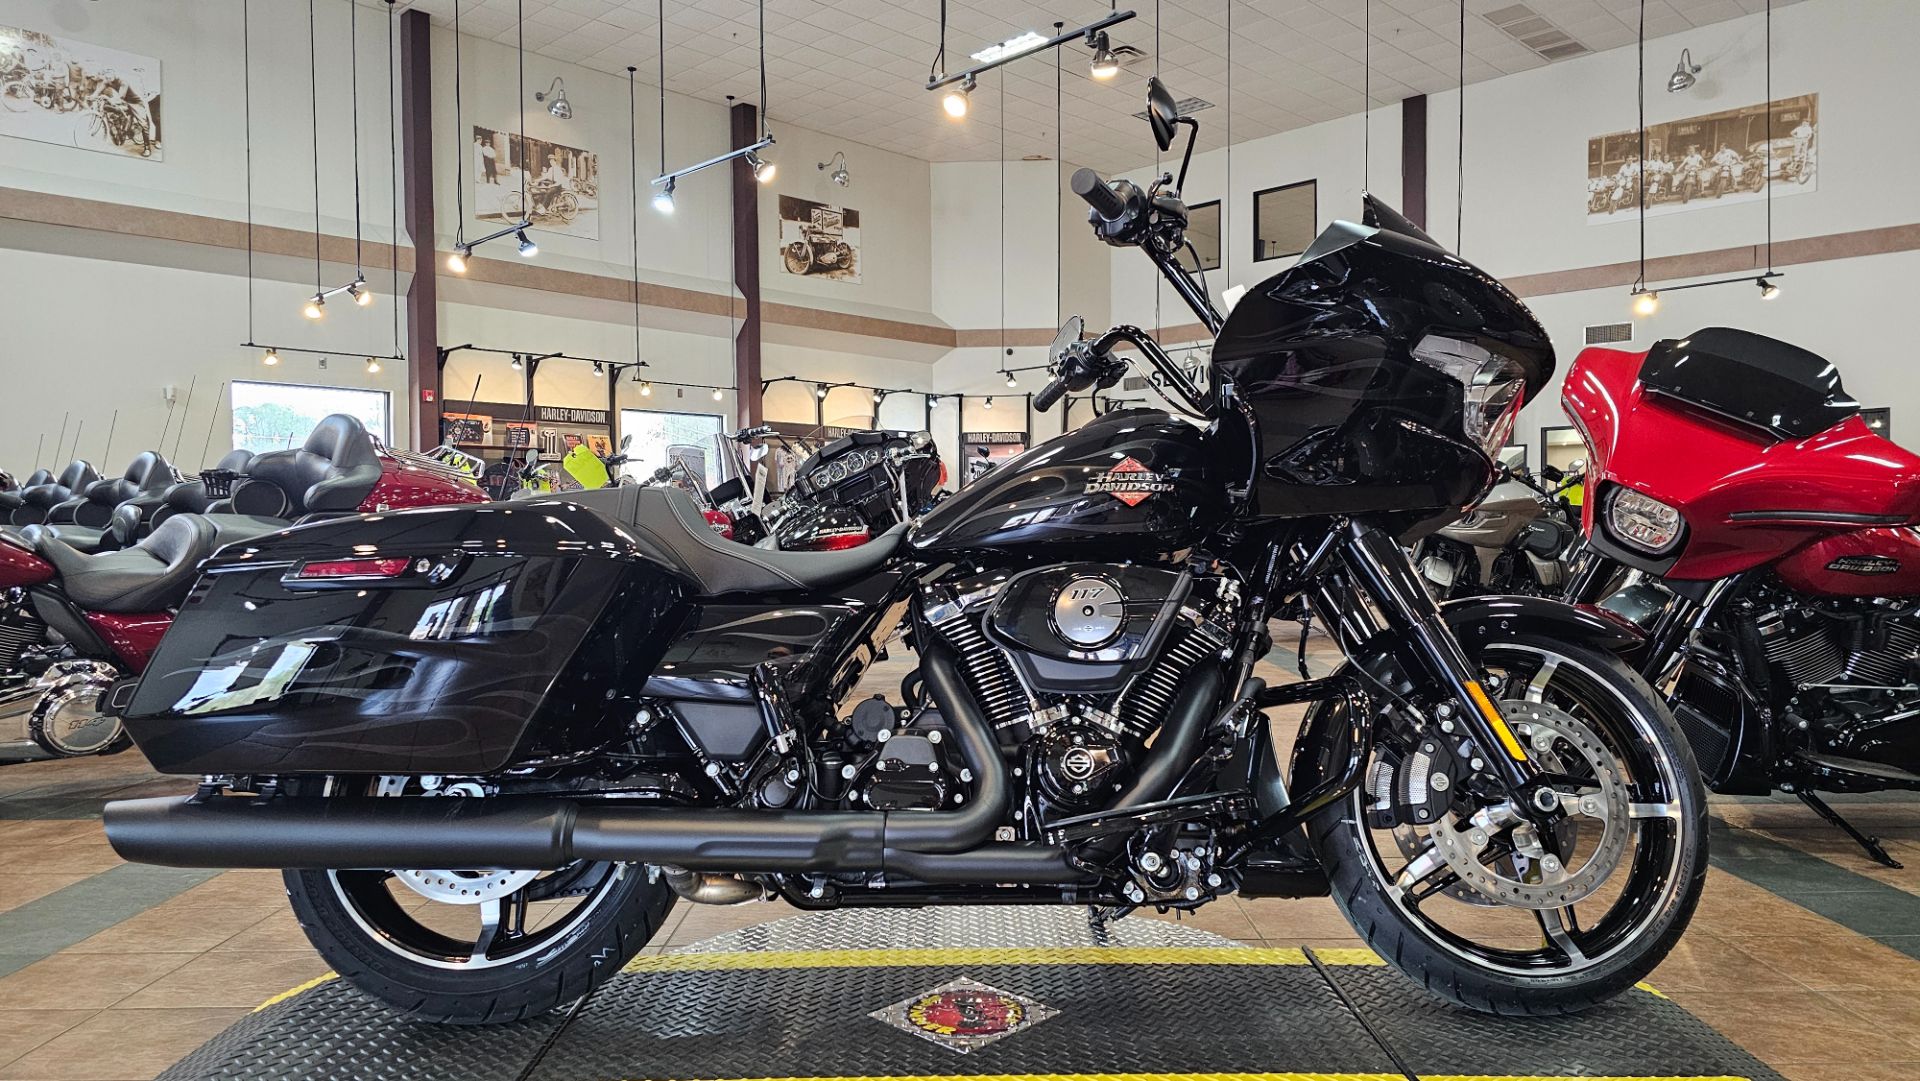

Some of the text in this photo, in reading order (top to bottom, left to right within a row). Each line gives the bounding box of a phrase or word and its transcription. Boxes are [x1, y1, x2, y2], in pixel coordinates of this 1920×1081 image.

[541, 407, 606, 424] HARLEY-DAVIDSON
[967, 432, 1022, 443] HARLEY-DAVIDSON
[1083, 482, 1175, 495] DAVIDSON
[1828, 563, 1897, 572] DAVIDSON
[1070, 586, 1107, 600] 117
